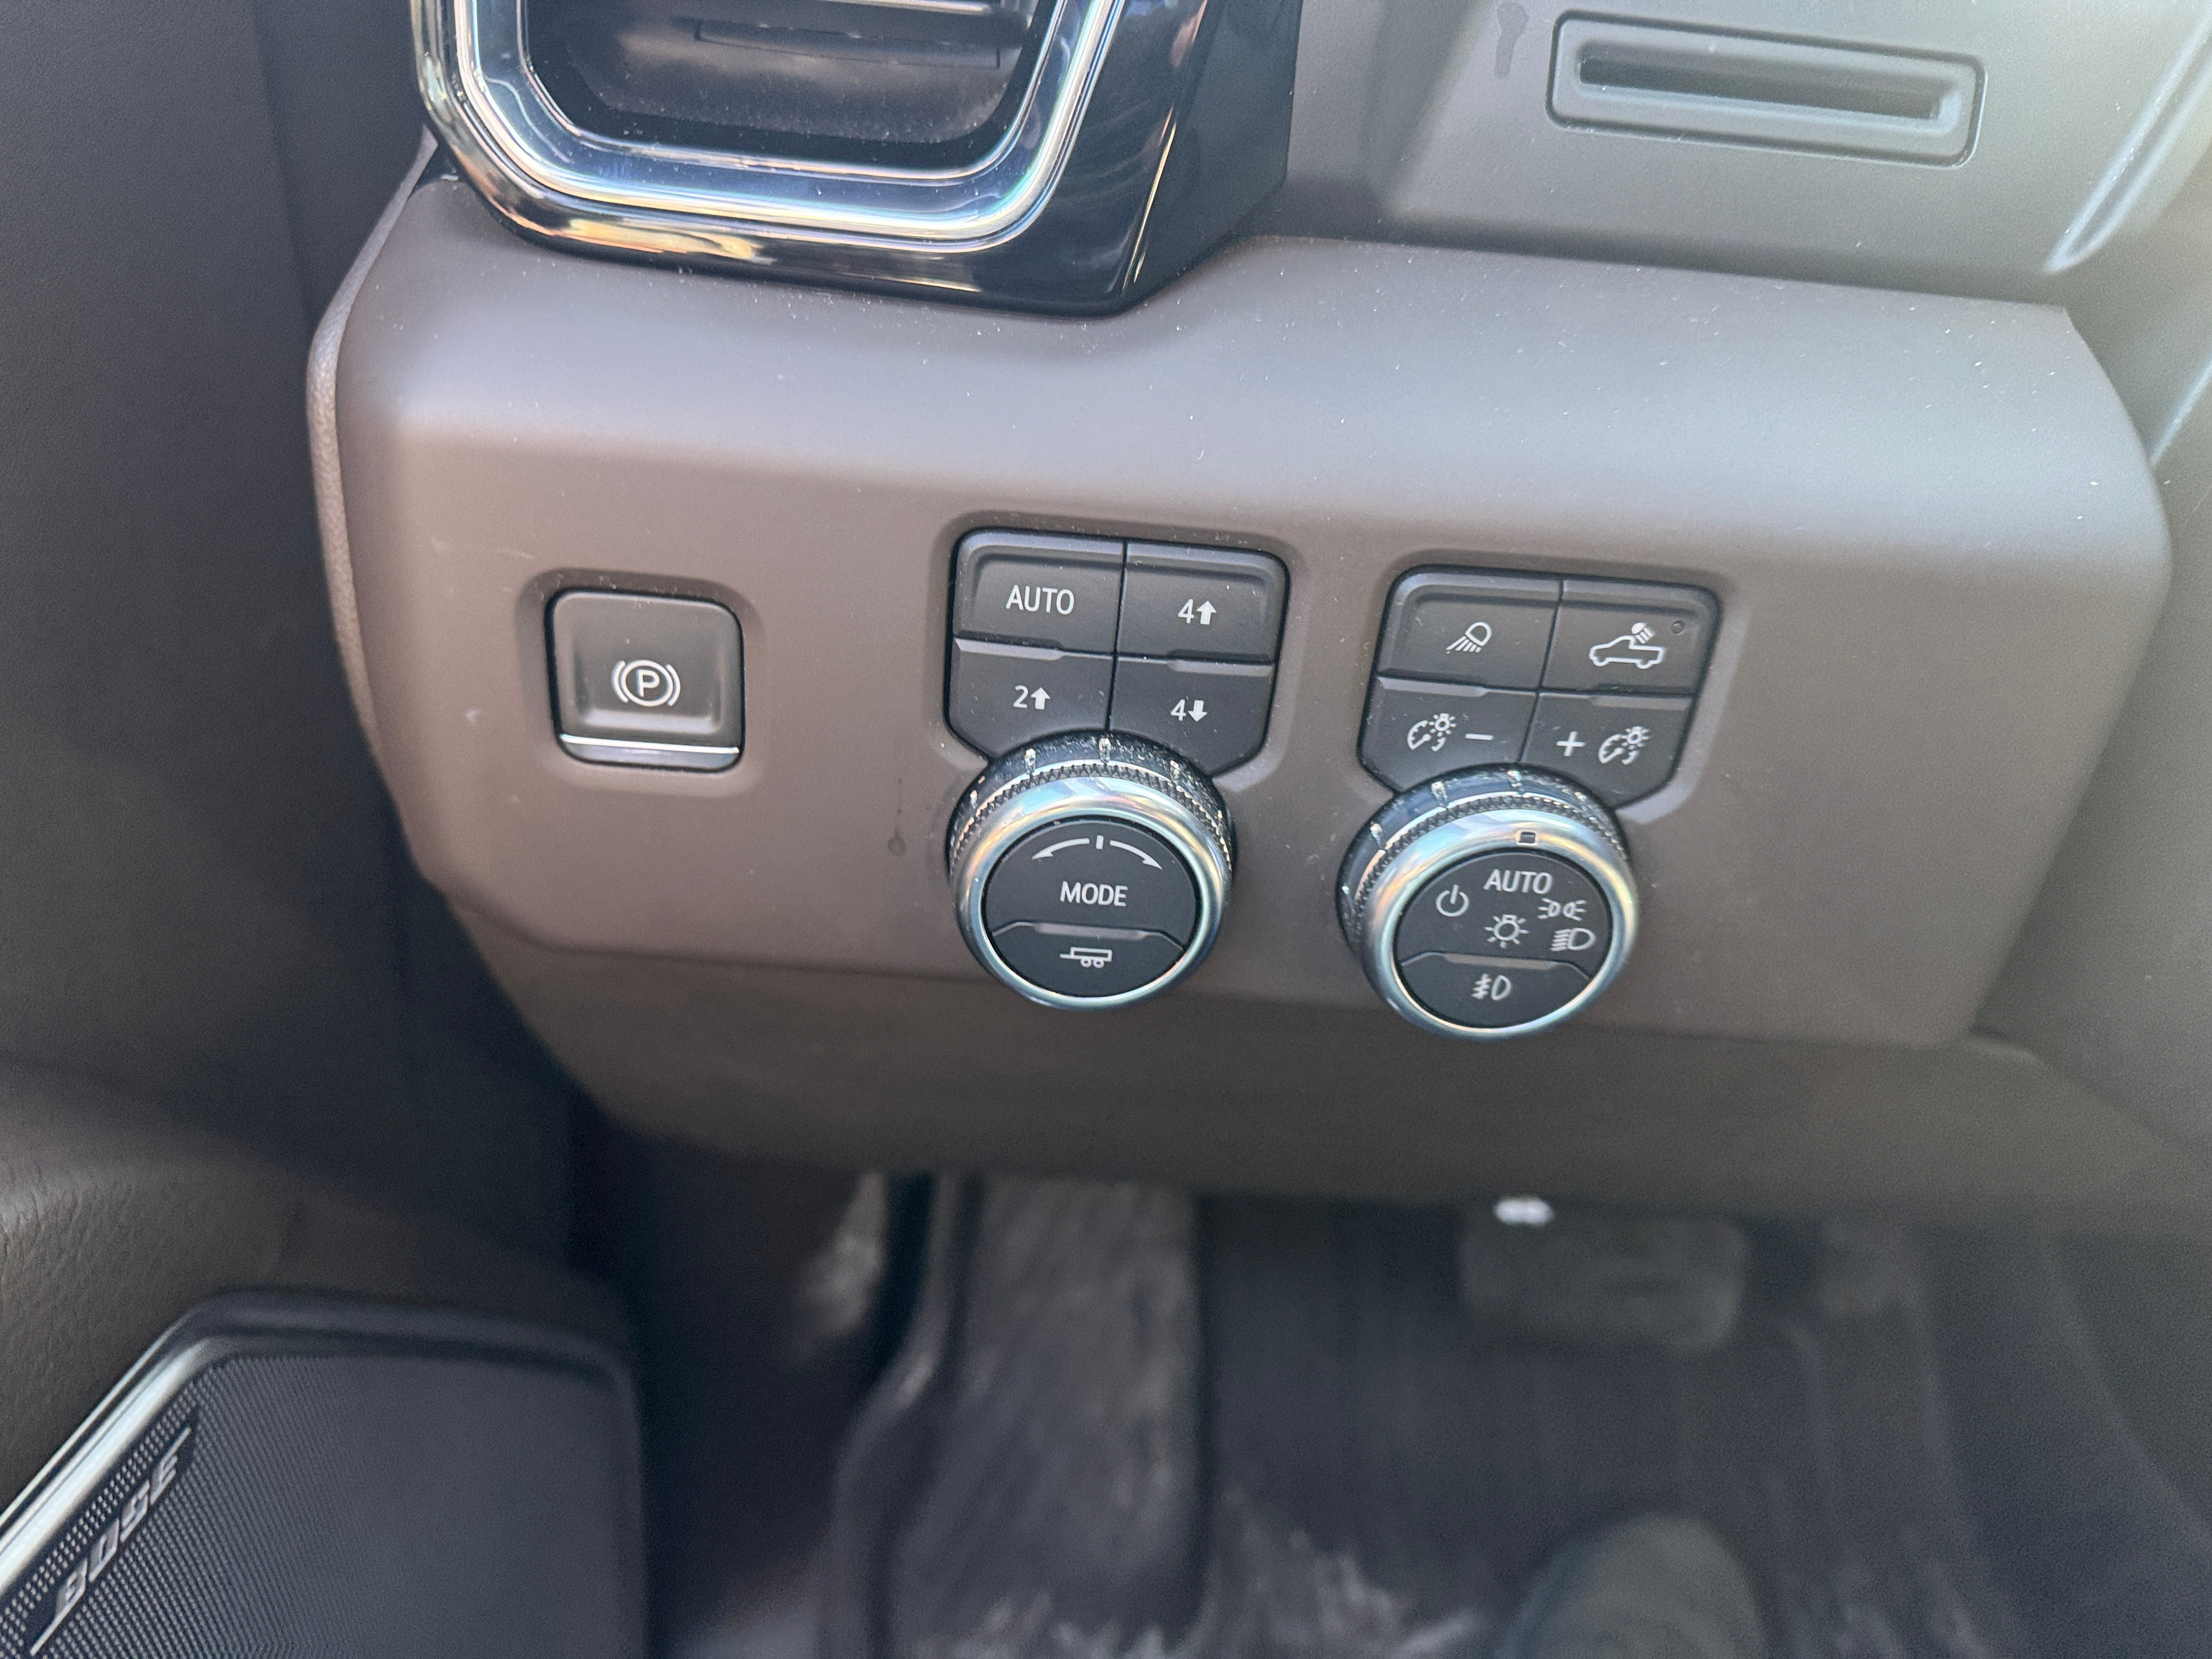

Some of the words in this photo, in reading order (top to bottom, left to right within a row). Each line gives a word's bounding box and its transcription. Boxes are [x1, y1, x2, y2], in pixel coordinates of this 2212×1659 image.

[1006, 585, 1075, 615] AUTO
[1178, 599, 1194, 623] 4
[637, 670, 659, 697] P
[1013, 685, 1028, 708] 2
[1171, 699, 1186, 721] 4
[1060, 881, 1128, 907] MODE
[1484, 869, 1553, 895] AUTO
[30, 1427, 191, 1656] BOSE
